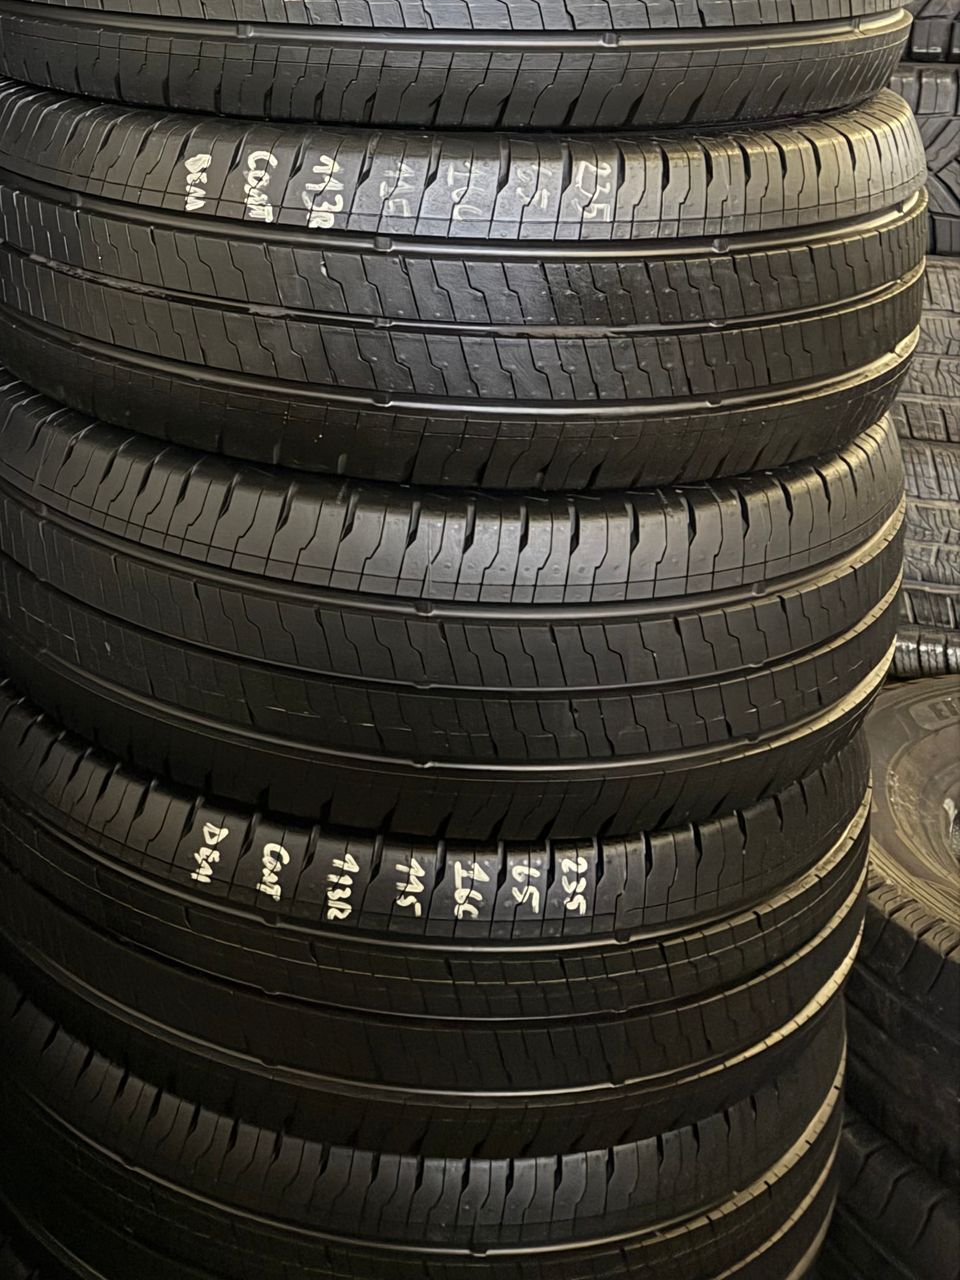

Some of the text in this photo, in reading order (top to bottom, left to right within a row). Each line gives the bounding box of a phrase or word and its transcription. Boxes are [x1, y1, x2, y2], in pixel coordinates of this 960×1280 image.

[302, 154, 344, 228] 113R
[574, 160, 613, 222] 235
[327, 853, 360, 920] 113R
[394, 857, 425, 917] 115
[453, 860, 490, 919] 16C
[511, 863, 540, 914] 65
[561, 856, 588, 916] 235
